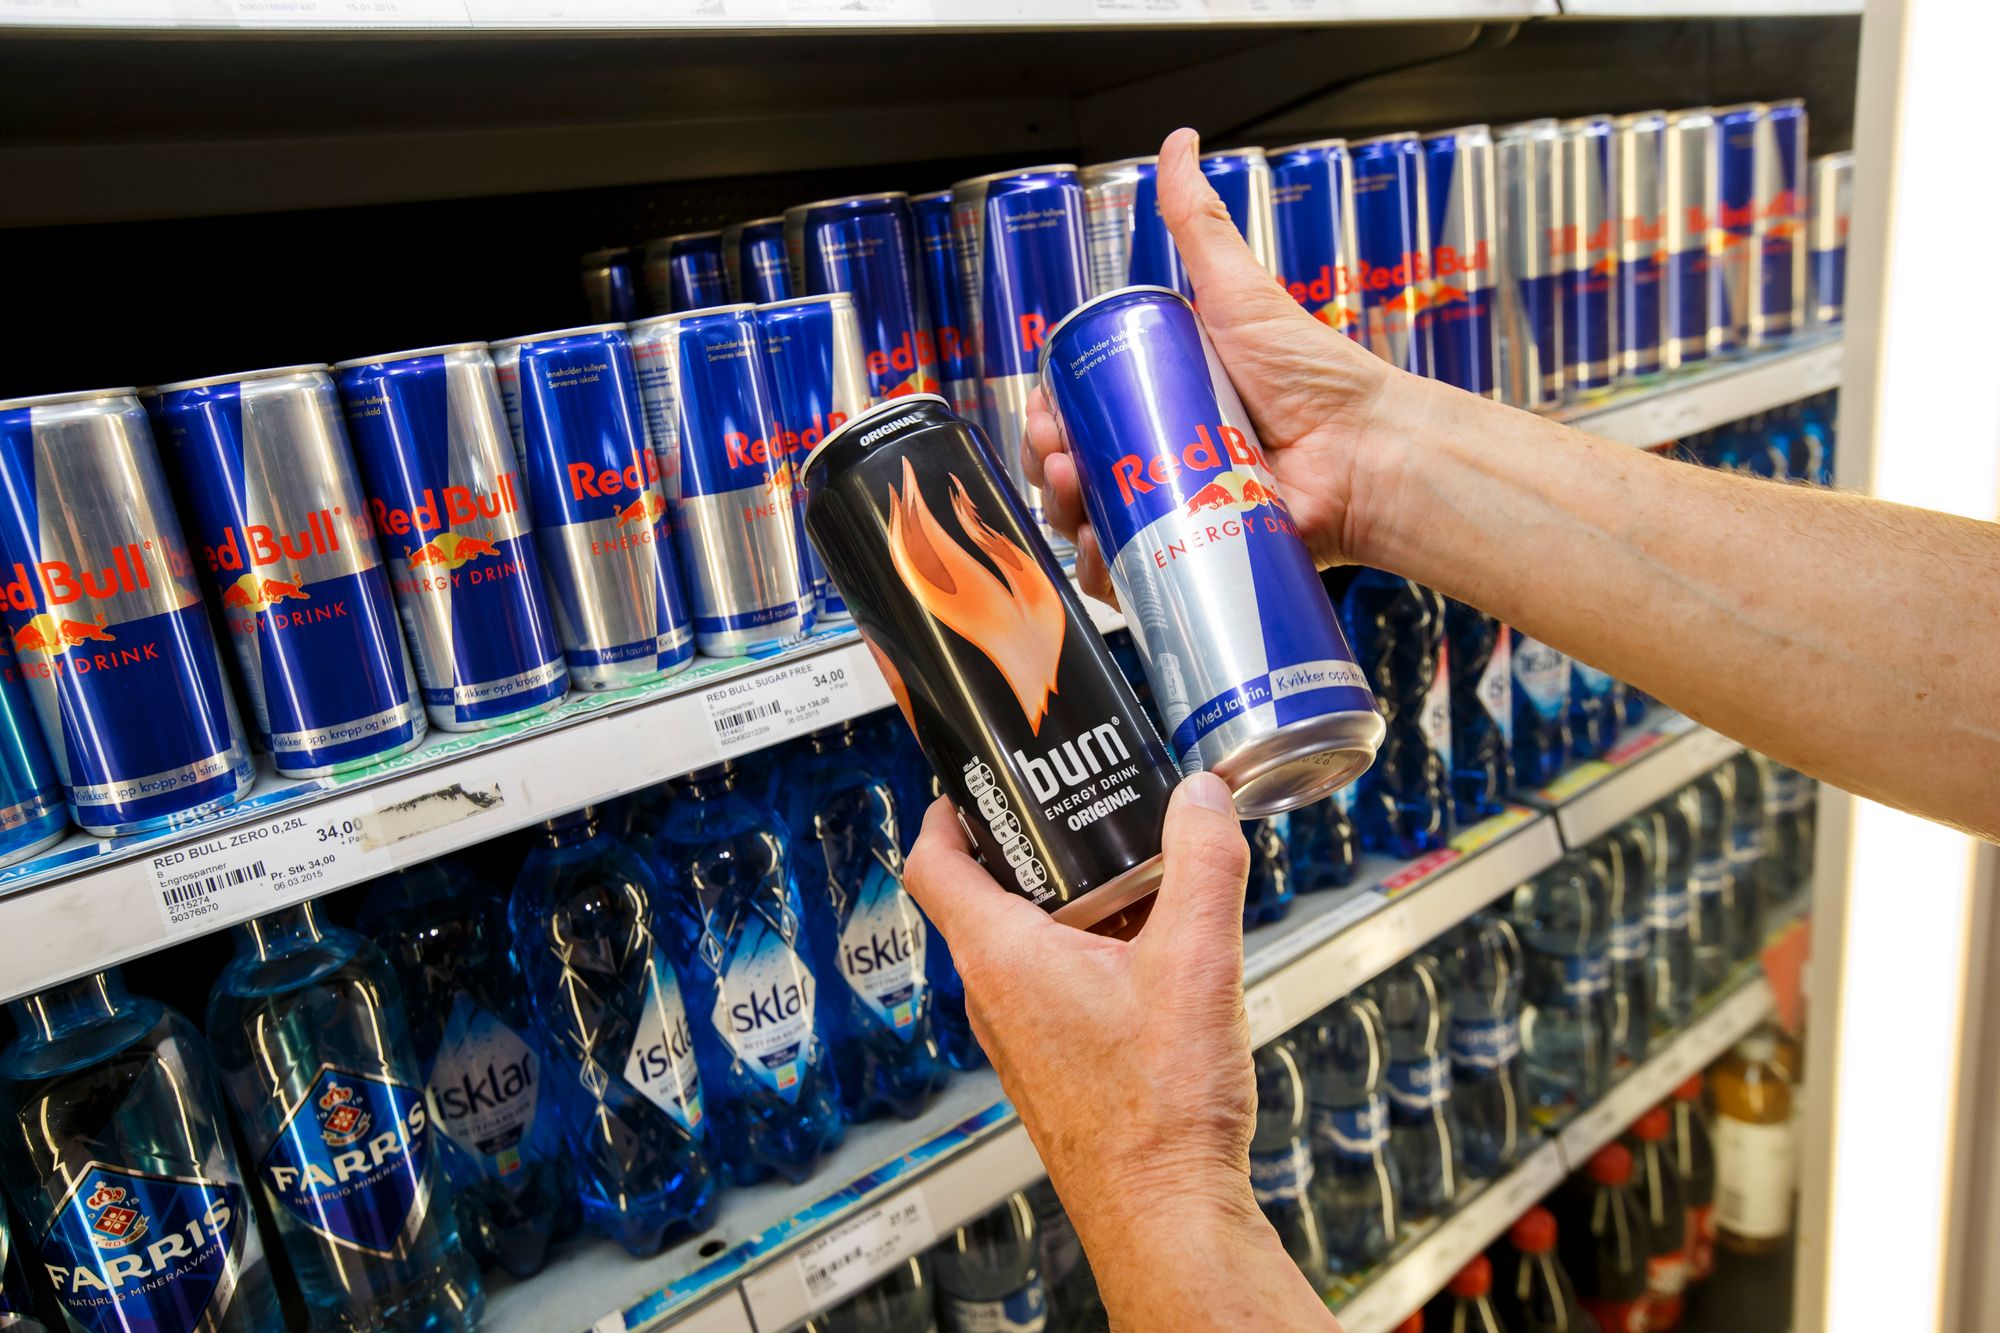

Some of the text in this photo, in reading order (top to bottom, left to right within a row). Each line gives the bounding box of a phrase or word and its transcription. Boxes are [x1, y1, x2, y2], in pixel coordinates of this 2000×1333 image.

[1070, 338, 1110, 369] Inneholder
[1074, 354, 1107, 380] Serveres
[545, 366, 582, 379] Inneholder
[548, 379, 578, 390] Serveres
[724, 422, 782, 470] Red
[859, 414, 922, 448] ORIGINAL
[567, 448, 646, 501] Red
[1111, 425, 1223, 506] Red
[371, 473, 520, 537] Red Bull
[242, 508, 341, 567] Bull
[591, 527, 659, 557] ENERGY
[1153, 516, 1255, 569] ENERGY
[34, 542, 151, 606] Bull
[276, 600, 348, 630] DRINK
[76, 641, 161, 675] DRINK
[602, 648, 624, 662] Med
[493, 683, 514, 695] opp
[515, 674, 541, 689] kropp
[706, 663, 814, 703] RED BULL SUGAR FREE
[812, 668, 845, 688] 34,00
[784, 709, 794, 717] Pr.
[1196, 706, 1223, 731] Med
[1276, 670, 1326, 692] Kvikker
[1328, 669, 1350, 682] opp
[329, 724, 363, 741] kropp
[365, 719, 380, 733] og
[1013, 722, 1131, 805] burn
[74, 788, 110, 803] Kvikker
[139, 775, 178, 795] kropp
[180, 770, 197, 785] og
[1044, 764, 1141, 822] ENERGY DRINK
[1067, 784, 1141, 832] ORIGINAL
[153, 817, 308, 870] RED BULL ZERO 0,25L
[316, 817, 364, 842] 34,00
[160, 861, 228, 889] Engrospartner
[270, 854, 337, 882] Pr. Stk 34,00
[168, 895, 211, 915] 2715274
[171, 902, 219, 924] 90376870
[844, 920, 922, 976] isklar
[432, 1053, 532, 1121] isklar
[270, 1100, 426, 1192] FARRIS
[44, 1196, 232, 1293] FARRIS
